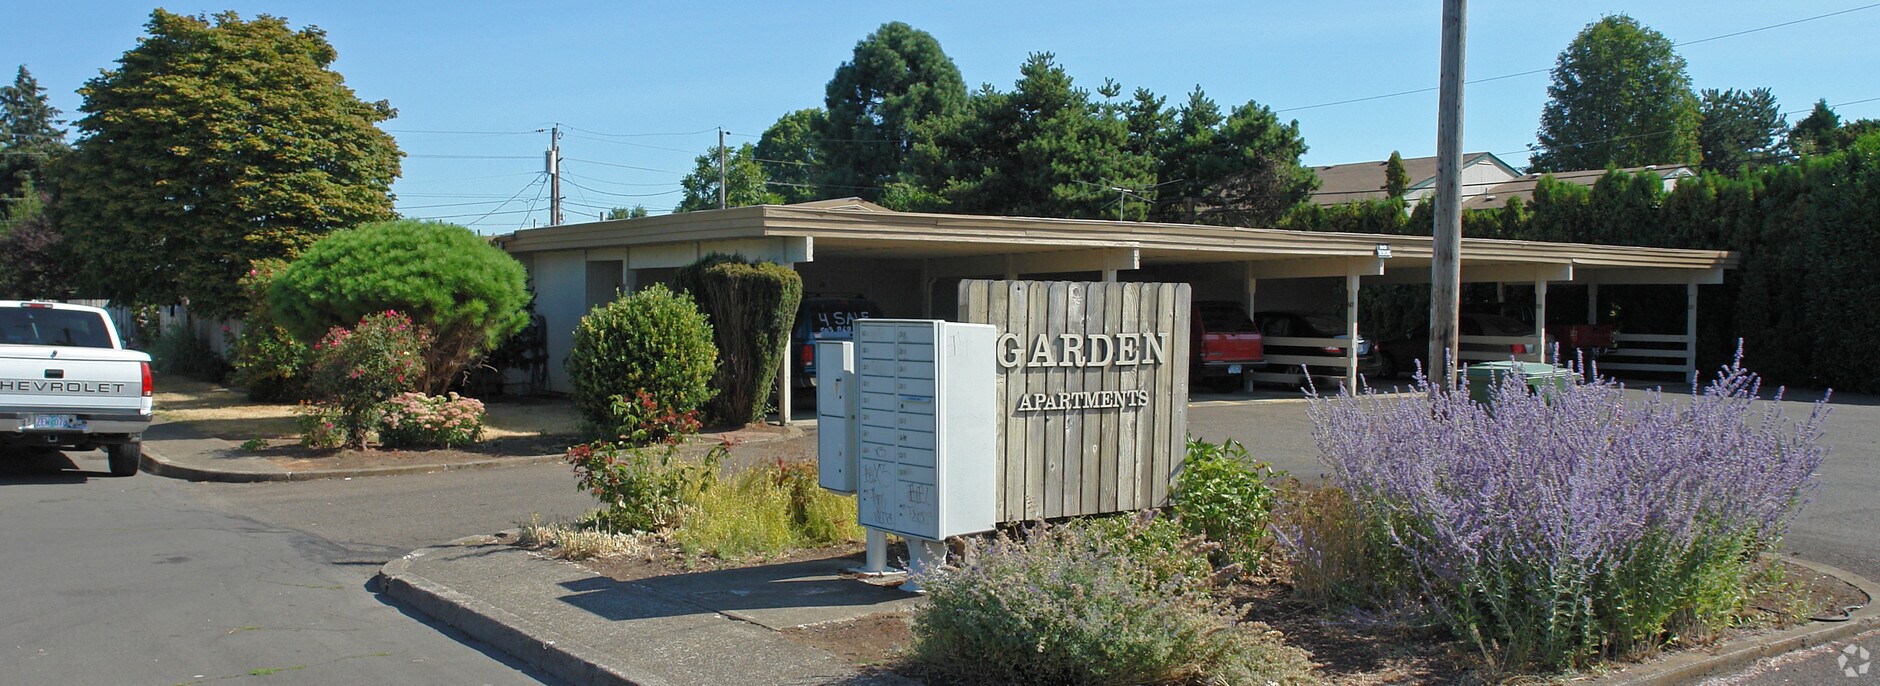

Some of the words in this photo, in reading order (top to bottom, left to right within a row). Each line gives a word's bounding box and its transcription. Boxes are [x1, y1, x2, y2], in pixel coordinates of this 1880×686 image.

[818, 312, 829, 326] 4
[997, 333, 1169, 368] GARDEN
[0, 381, 125, 393] HEVROLET
[1017, 389, 1150, 412] APARTMENTS
